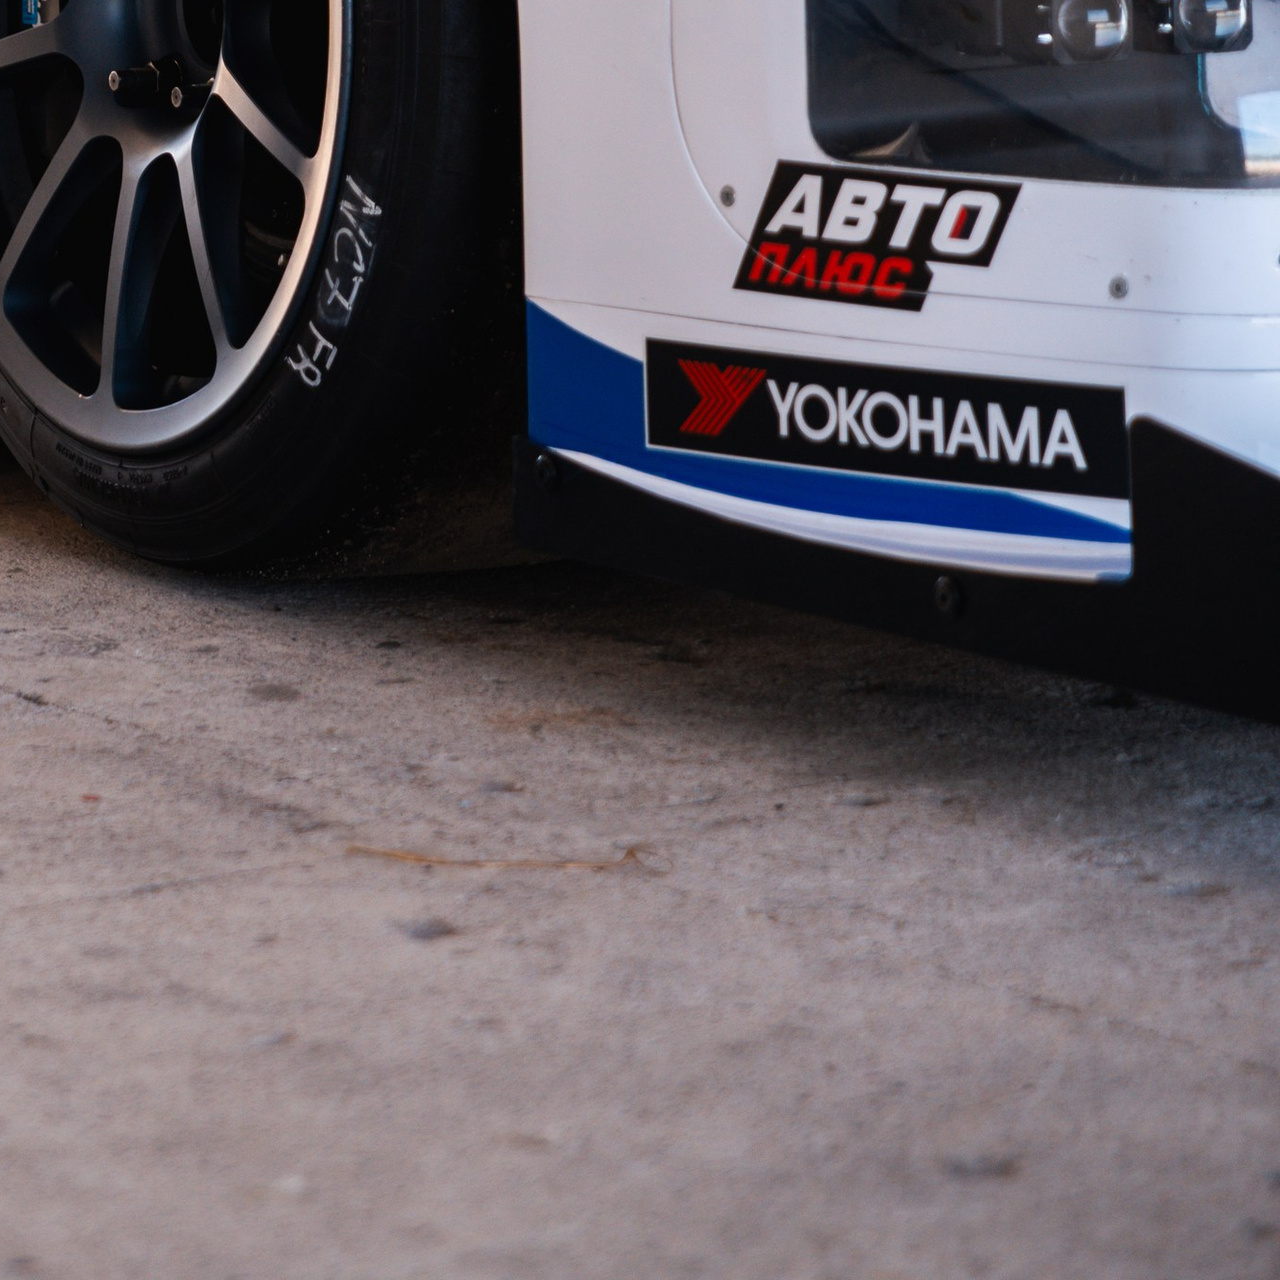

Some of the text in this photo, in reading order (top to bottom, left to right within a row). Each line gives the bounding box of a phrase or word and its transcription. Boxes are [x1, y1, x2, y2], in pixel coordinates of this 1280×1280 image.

[765, 174, 1001, 256] АВТО
[749, 242, 914, 298] ПЛЮС
[766, 379, 1088, 471] YOKOHAMA
